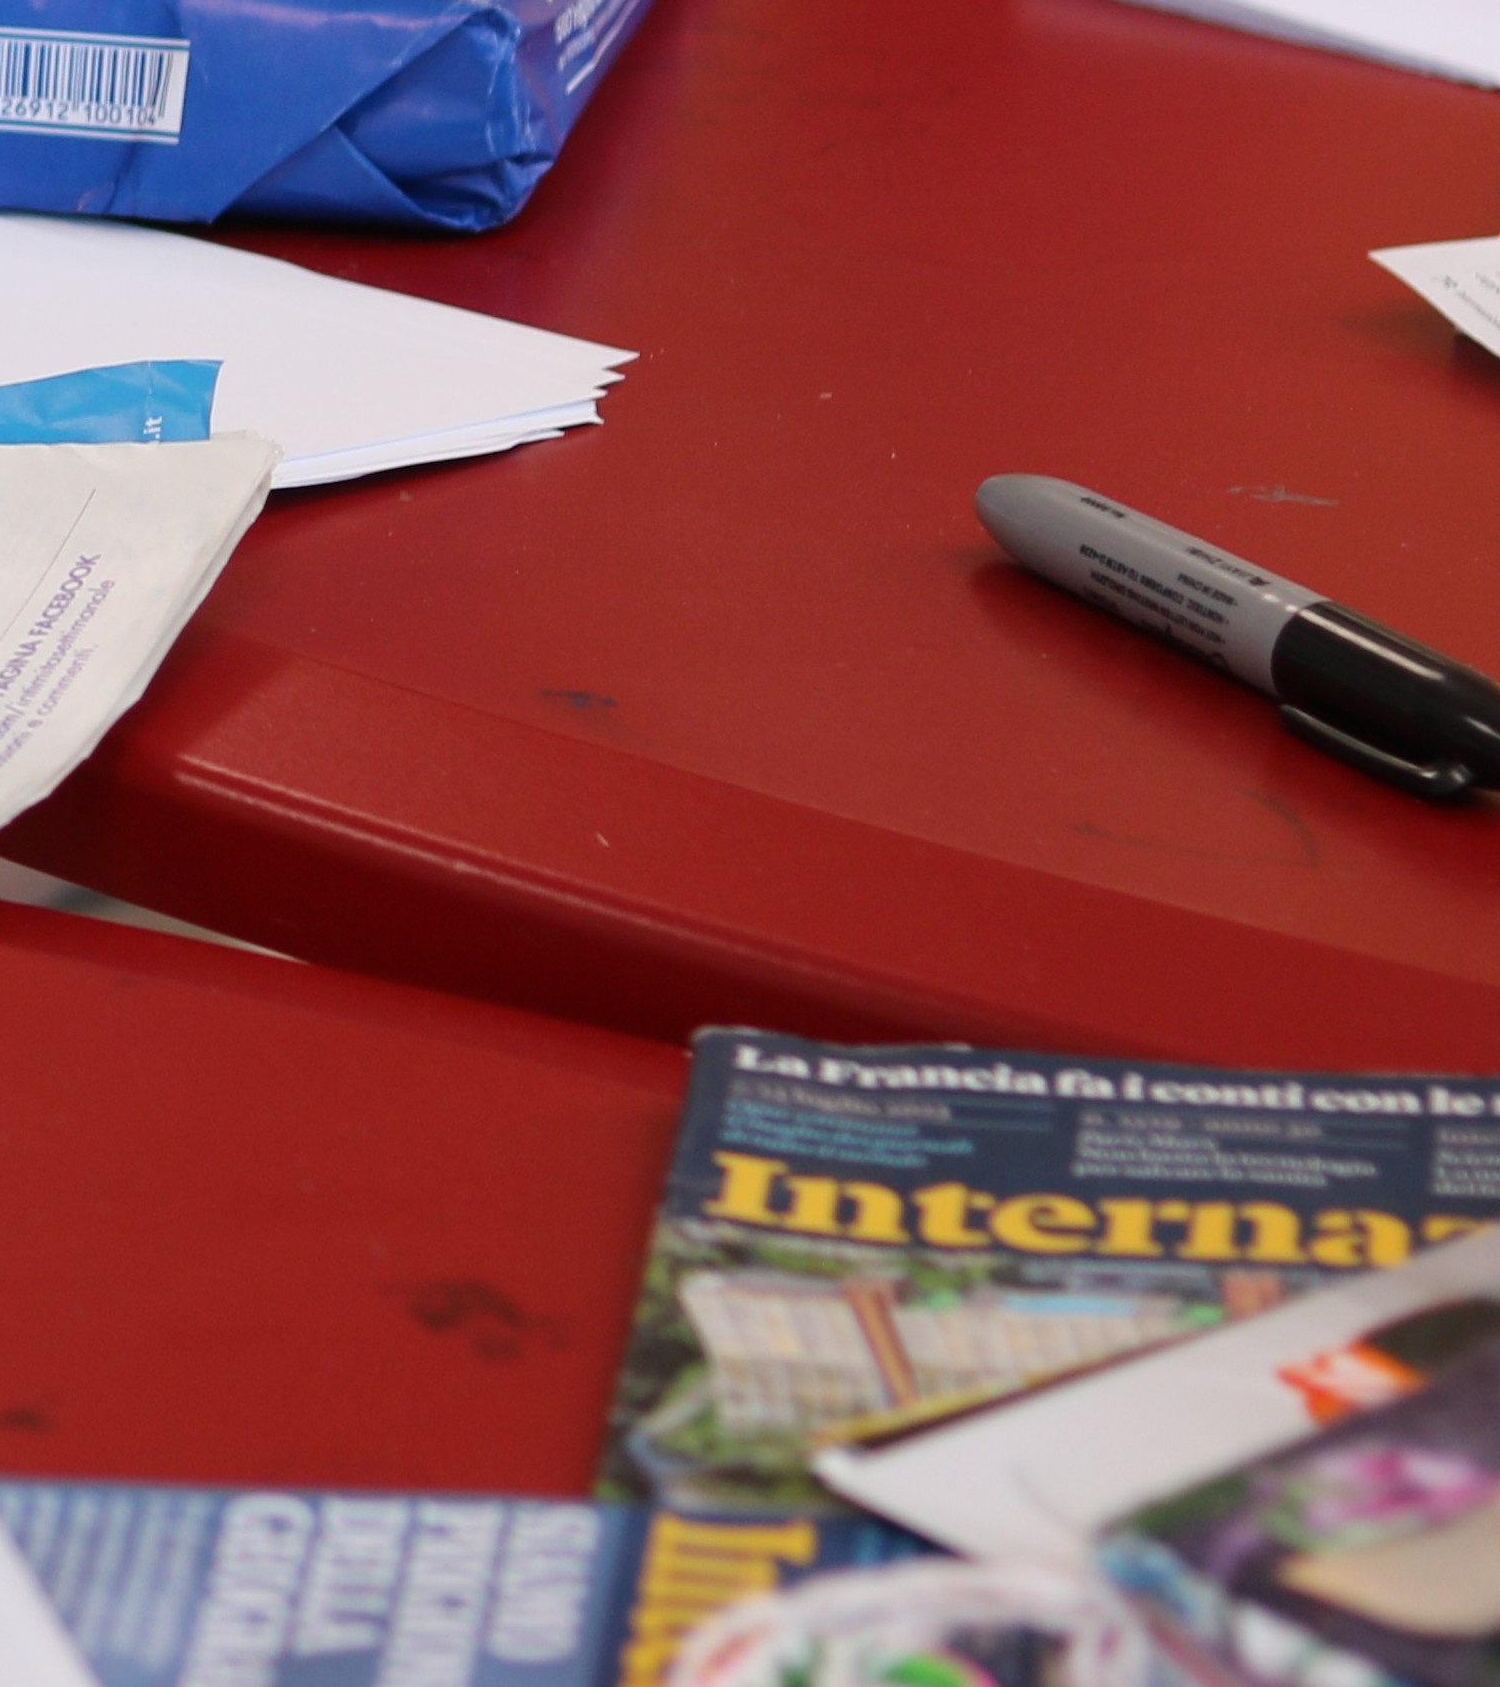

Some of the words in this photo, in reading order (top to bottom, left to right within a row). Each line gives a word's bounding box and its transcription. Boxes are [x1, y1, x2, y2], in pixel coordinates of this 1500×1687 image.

[26, 551, 102, 637] FACEBOOK
[733, 1045, 810, 1082] La
[818, 1055, 1050, 1098] Francia
[1055, 1068, 1117, 1103] fa
[1124, 1073, 1147, 1103] i
[1150, 1075, 1305, 1111] conti
[1310, 1086, 1422, 1115] con
[1426, 1085, 1485, 1117] le
